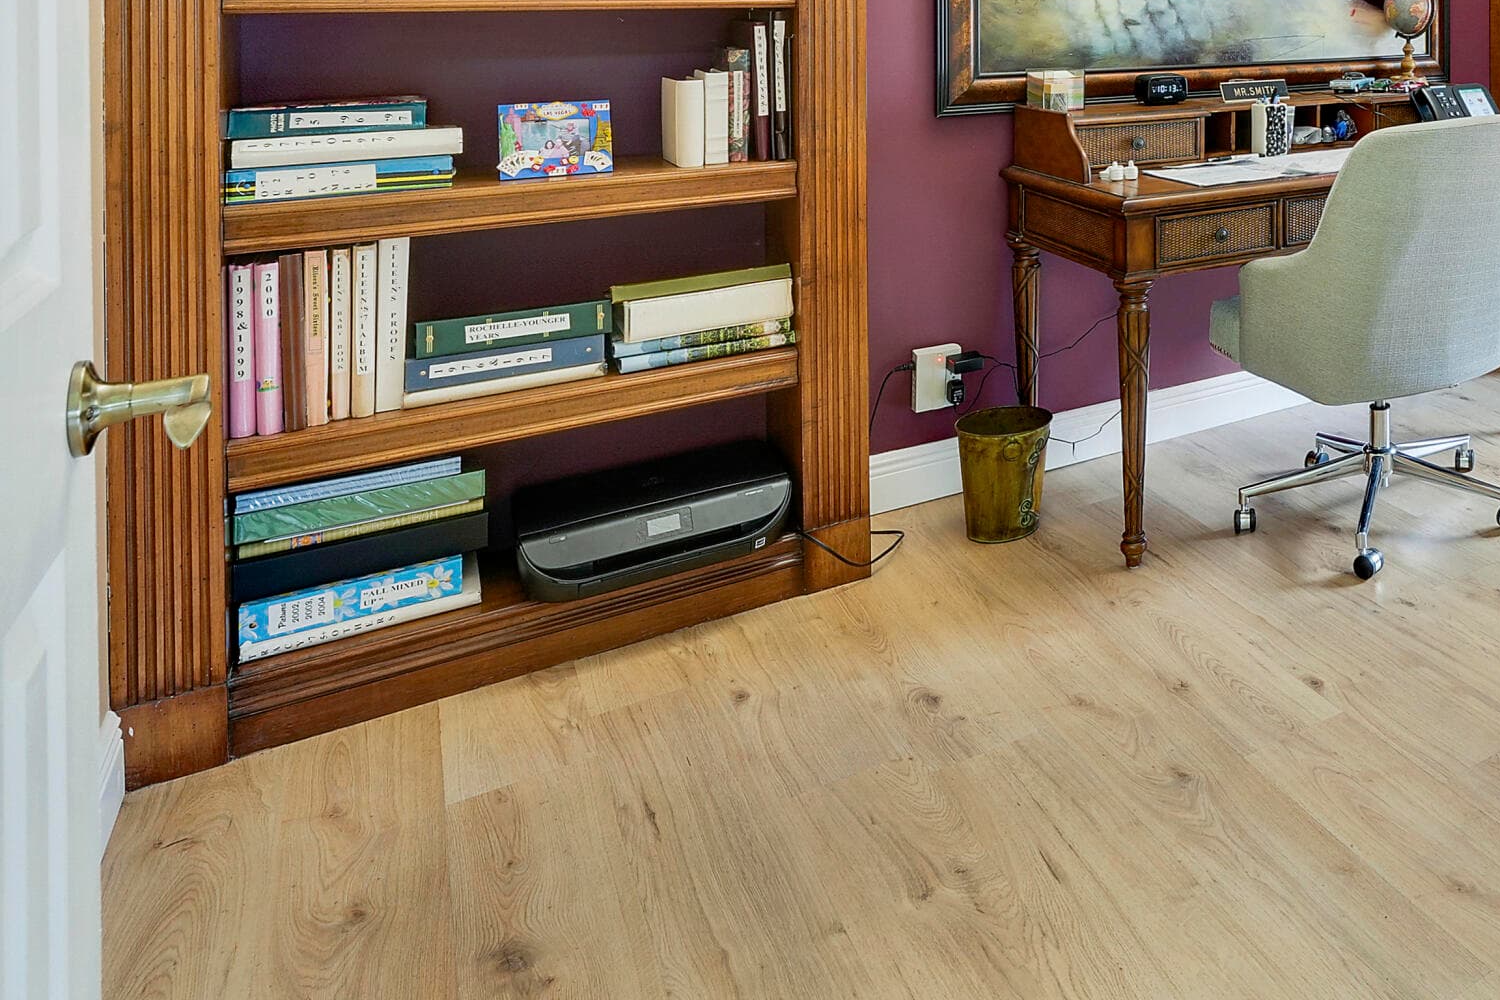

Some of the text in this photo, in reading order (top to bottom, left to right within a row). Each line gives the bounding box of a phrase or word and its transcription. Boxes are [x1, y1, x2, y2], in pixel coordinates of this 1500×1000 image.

[263, 273, 273, 316] 2000
[312, 292, 320, 307] Sweet
[469, 316, 566, 333] ROCHELLE-YOUNGER
[389, 312, 398, 361] PROOFS
[469, 332, 500, 341] YEARS
[390, 579, 424, 593] MIXED
